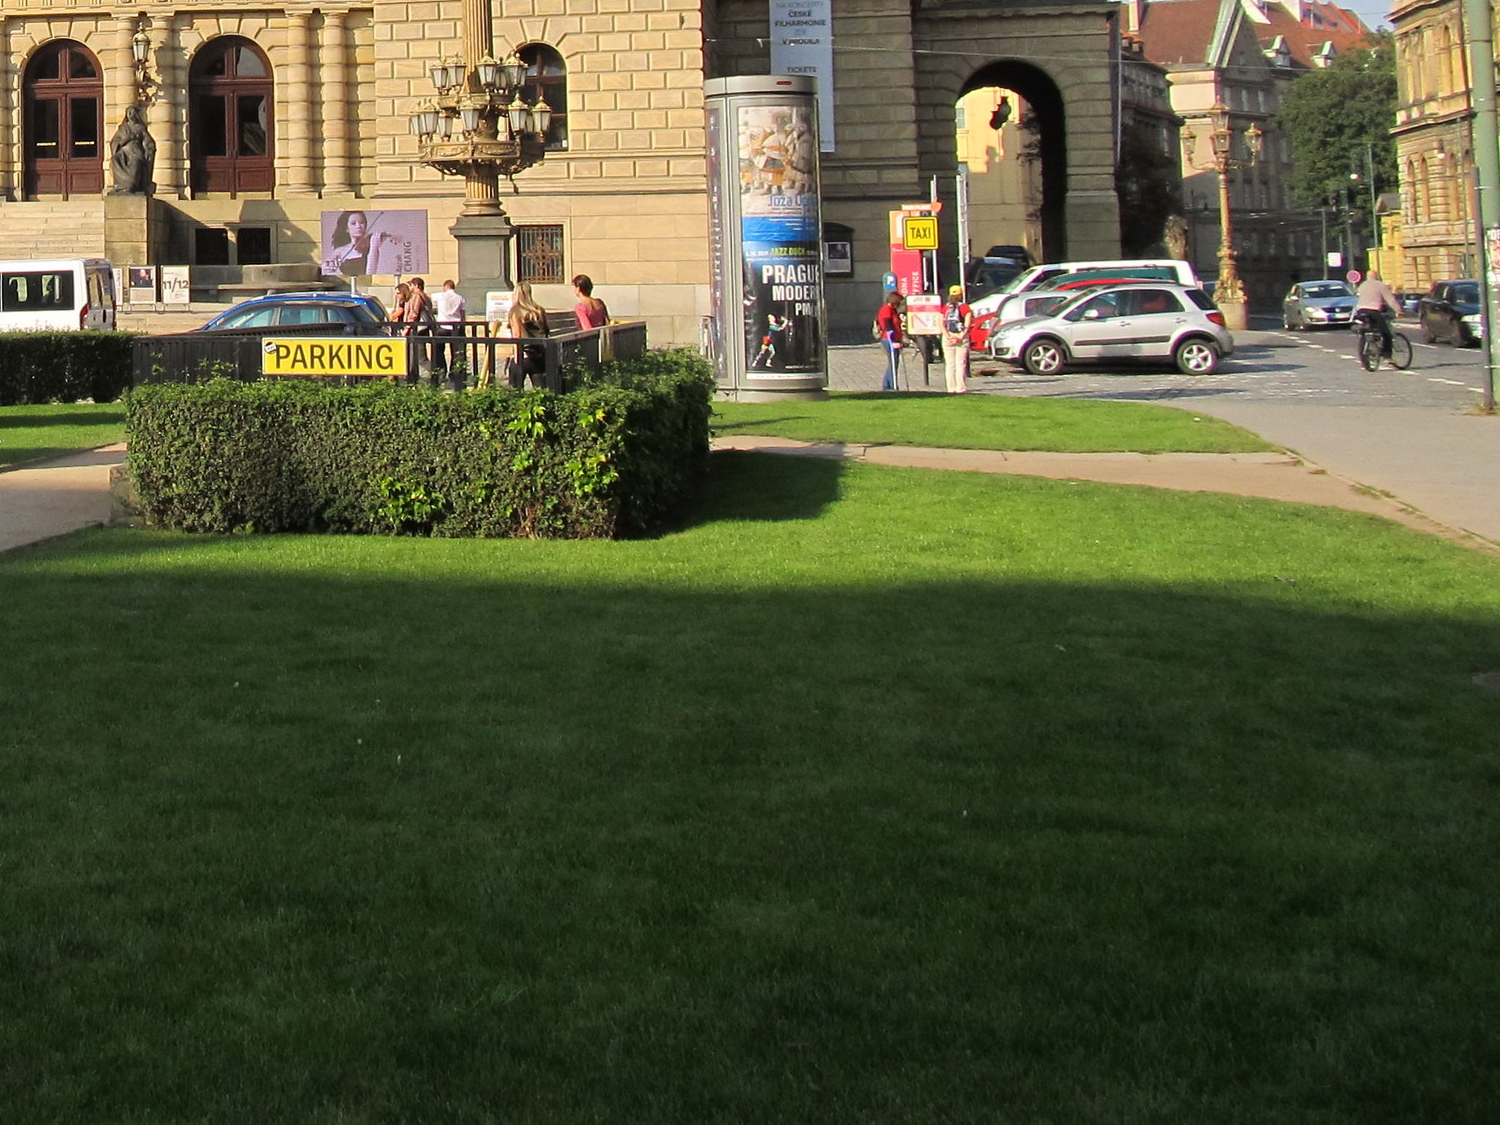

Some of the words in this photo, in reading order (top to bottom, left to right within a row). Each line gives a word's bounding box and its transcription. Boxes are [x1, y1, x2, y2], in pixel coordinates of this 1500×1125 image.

[774, 19, 827, 27] FILHARMONIE
[910, 227, 931, 239] TAXI
[403, 241, 413, 273] CHANG
[162, 277, 189, 293] 11/12
[911, 271, 920, 295] FFICE
[275, 344, 394, 370] PARKING
